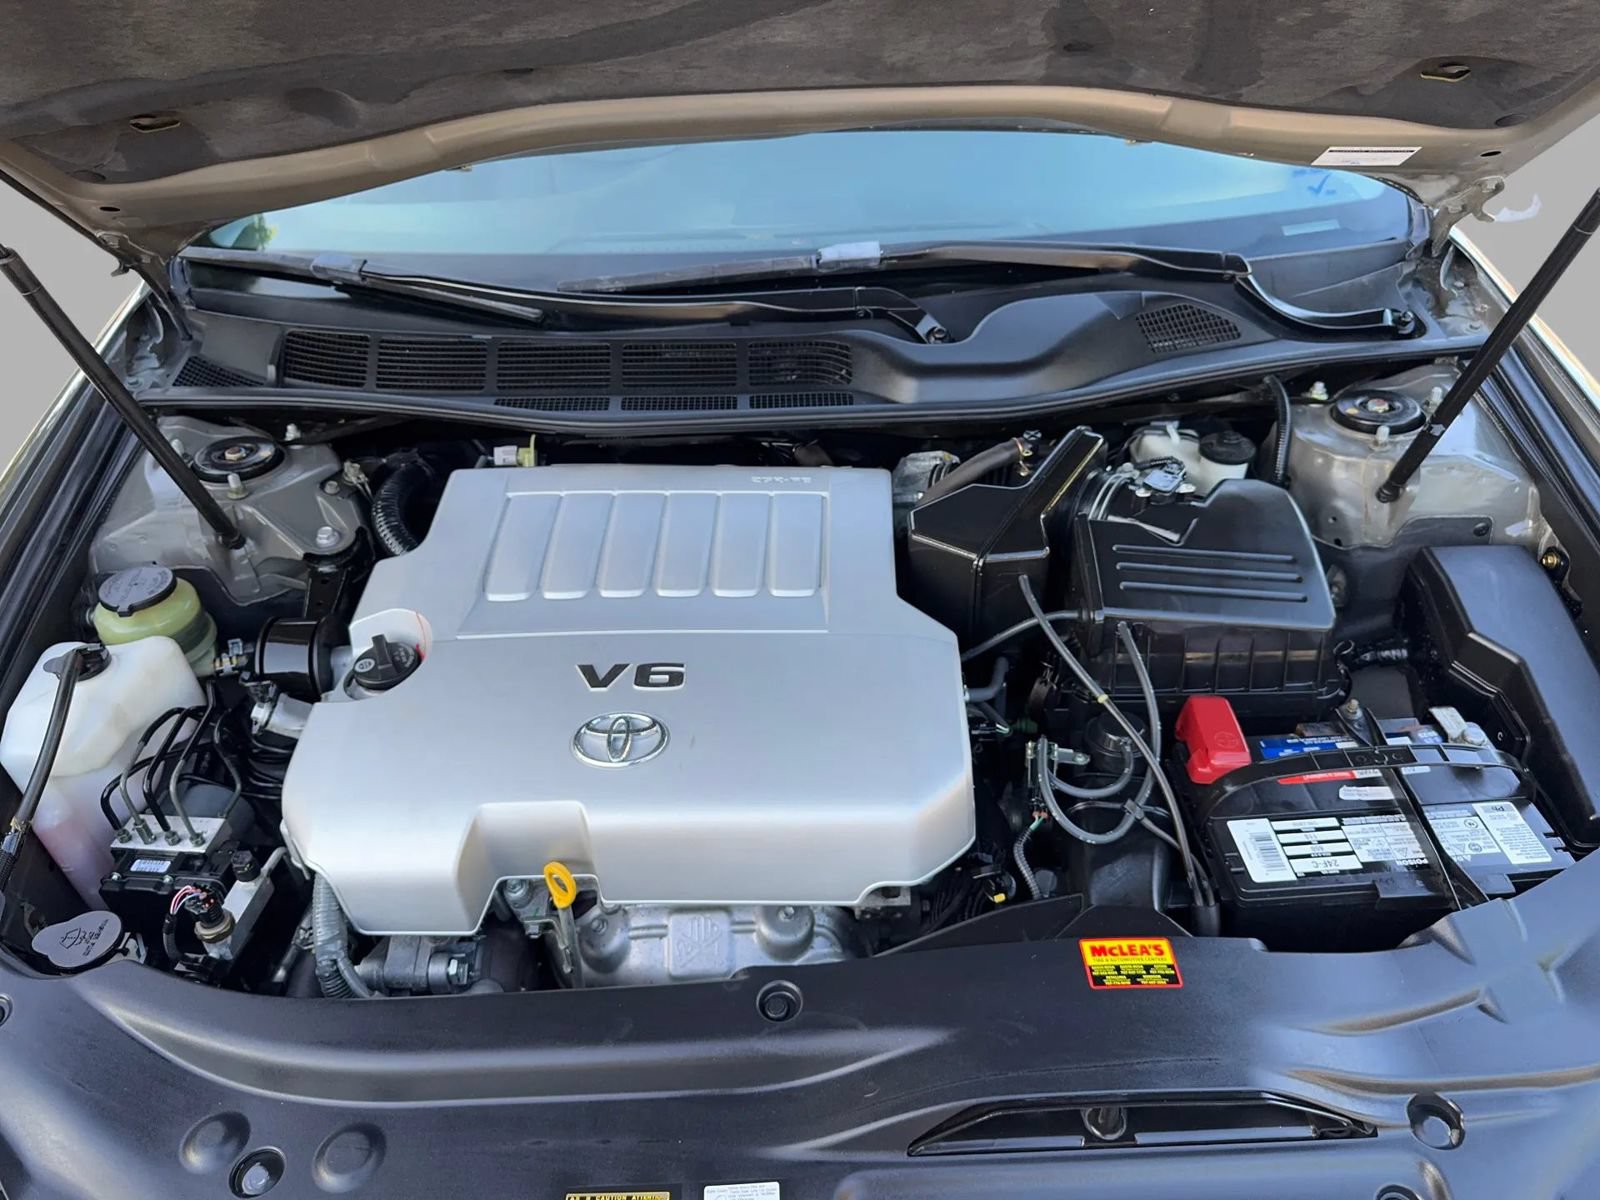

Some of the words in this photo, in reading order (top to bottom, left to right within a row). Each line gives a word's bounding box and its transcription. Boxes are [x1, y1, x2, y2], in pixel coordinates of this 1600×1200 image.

[577, 662, 686, 691] V6
[1311, 859, 1340, 869] 24F-C
[1395, 857, 1429, 867] POISON
